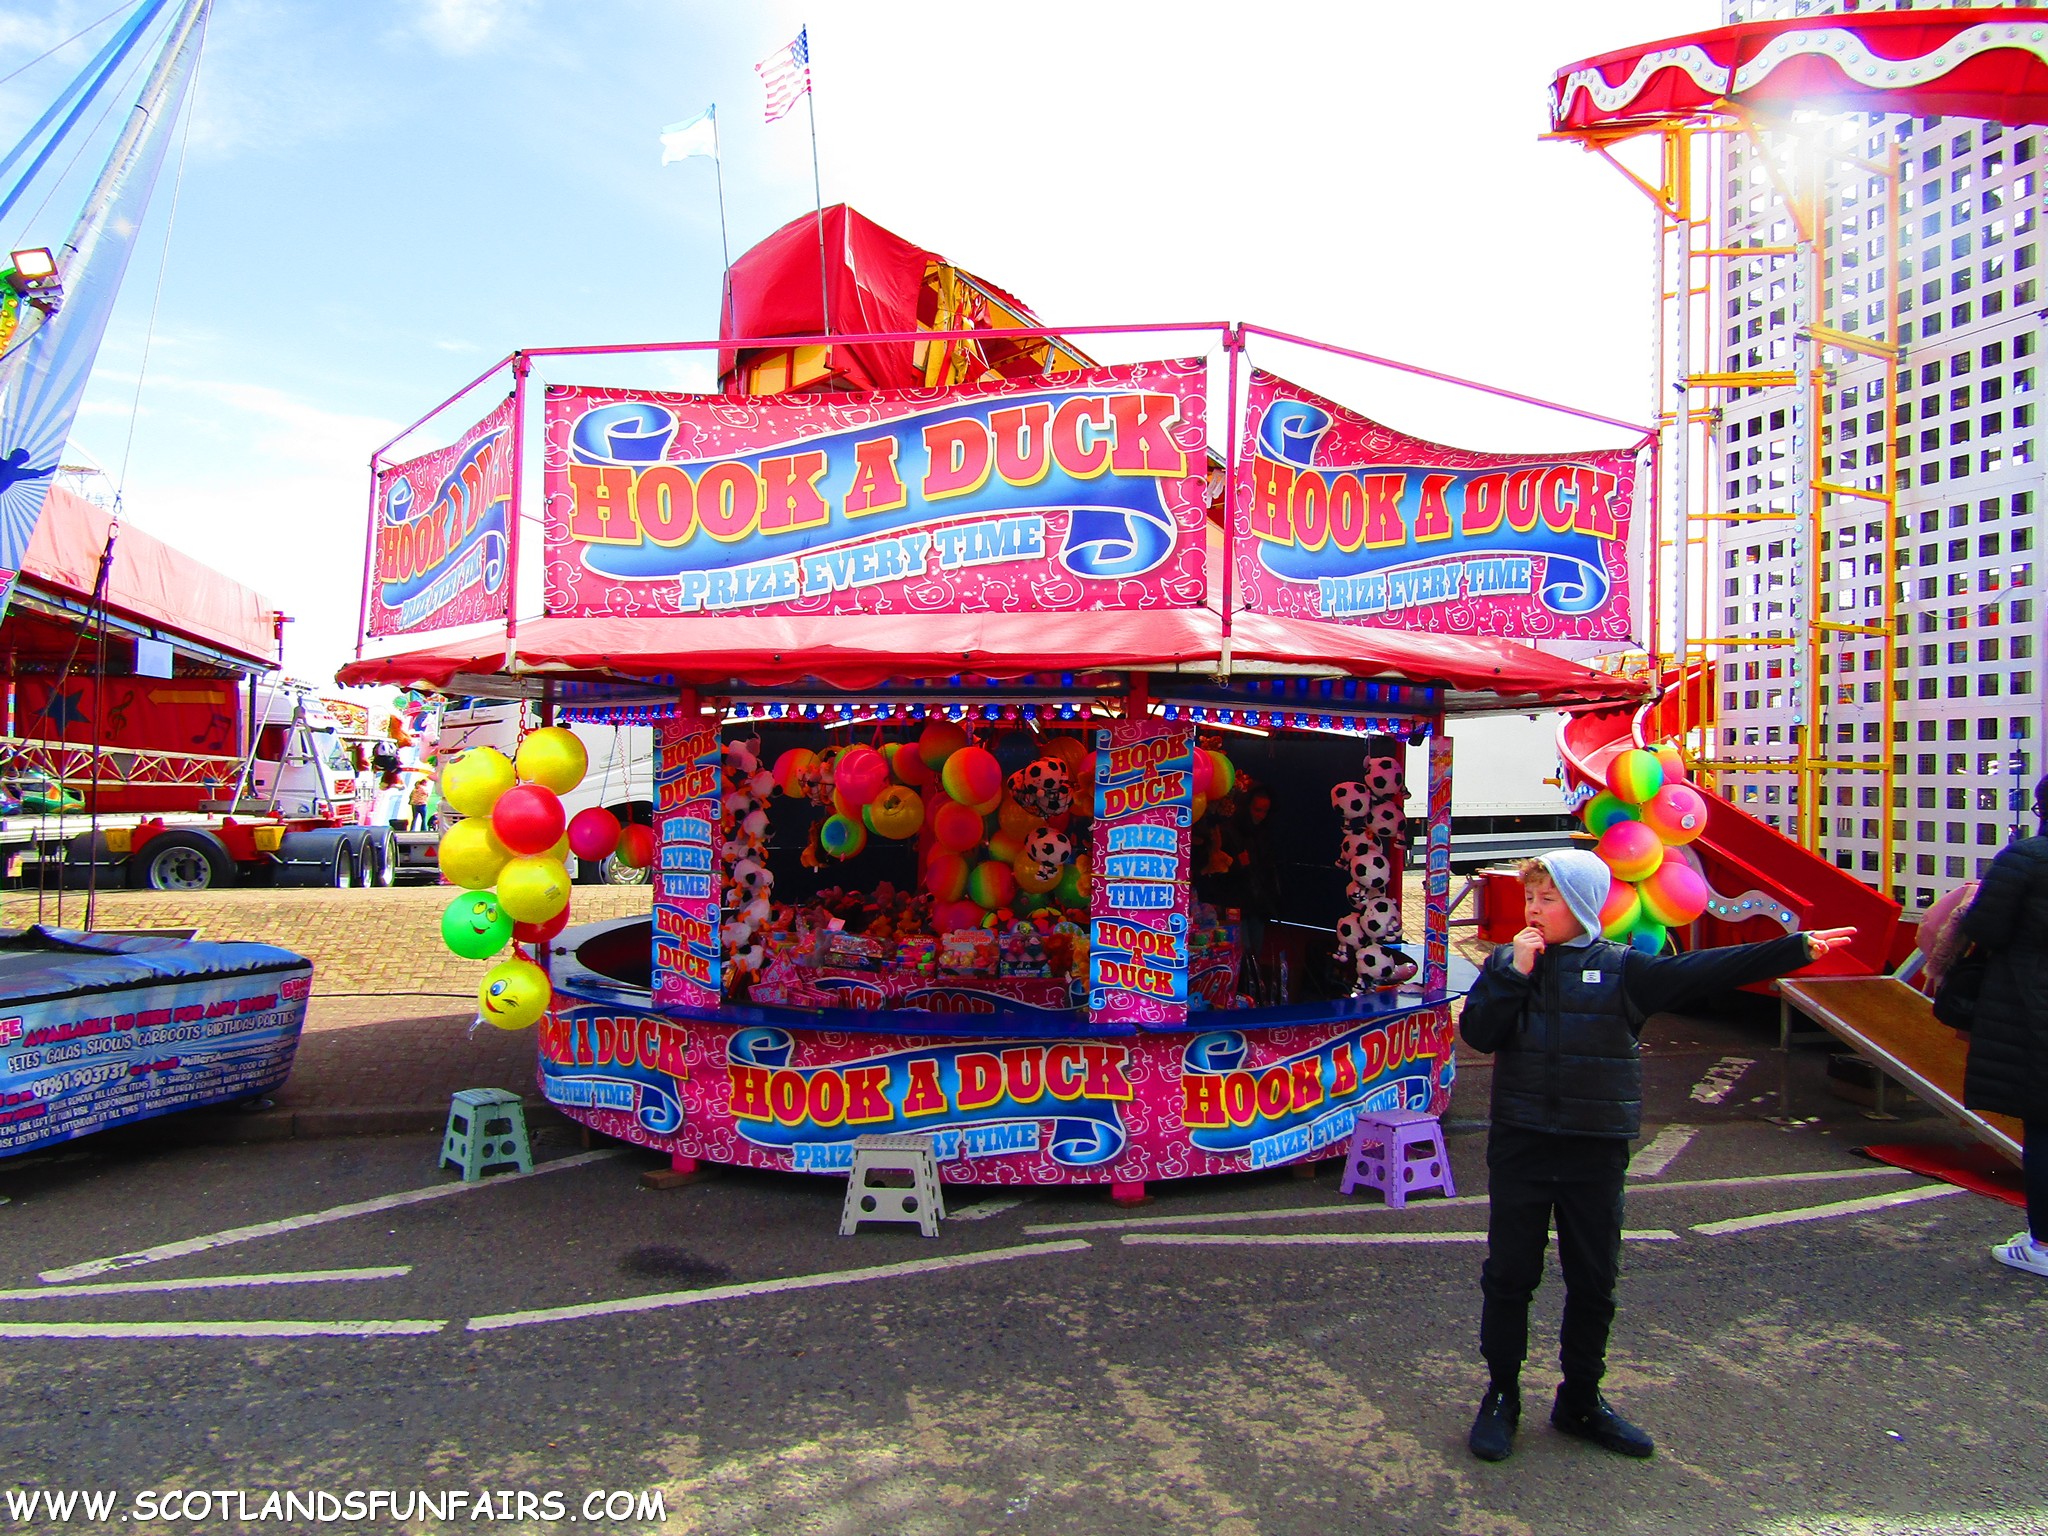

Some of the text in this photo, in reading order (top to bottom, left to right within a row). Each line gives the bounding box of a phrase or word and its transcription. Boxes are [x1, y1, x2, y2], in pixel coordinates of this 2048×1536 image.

[568, 393, 1189, 548] HOOK A DUCK
[380, 432, 512, 584] HOOK A DUCK
[1251, 454, 1618, 553] HOOK A DUCK
[679, 517, 1045, 608] PRIZE EVERY TIME
[1319, 558, 1531, 616] PRIZE EVERY TIME
[662, 729, 717, 771] HOOK
[685, 754, 696, 777] A
[1110, 734, 1189, 776] HOOK
[1143, 759, 1158, 781] A
[659, 766, 716, 810] DUCK
[1104, 772, 1185, 817] DUCK
[663, 818, 710, 842] PRIZE
[1107, 825, 1178, 853] PRIZE
[662, 846, 712, 871] EVERY
[1106, 855, 1178, 880] EVERY
[663, 875, 710, 897] TIME!
[1107, 884, 1174, 909] TIME!
[657, 908, 713, 948] HOOK
[1097, 922, 1176, 959] HOOK
[1428, 908, 1447, 933] HOOK
[658, 943, 711, 983] DUCK
[680, 934, 690, 952] A
[1131, 947, 1146, 968] A
[1428, 942, 1446, 966] DUCK
[1099, 960, 1174, 997] DUCK
[7, 1009, 295, 1073] FETES GALAS SHOWS CARBOOTS BIRTHDAY PARTIES
[23, 1016, 112, 1047] AVAILABLE
[114, 1013, 135, 1031] TO
[136, 1008, 172, 1028] HIRE
[174, 1004, 204, 1022] FOR
[204, 1001, 237, 1018] ANY
[239, 994, 278, 1014] EVENT
[576, 1018, 594, 1065] A
[594, 1017, 689, 1080] DUCK
[728, 1044, 1134, 1127] HOOK A DUCK
[1182, 1055, 1323, 1128] HOOK
[1330, 1042, 1358, 1098] A
[1361, 1011, 1438, 1083] DUCK
[0, 1126, 17, 1138] TEMS
[32, 1116, 48, 1127] LEFT
[73, 1105, 90, 1117] RISK
[93, 1091, 145, 1112] RESPONSIBILITY
[146, 1088, 161, 1099] FOR
[162, 1081, 195, 1096] CHILDREN
[68, 1092, 94, 1105] REMOVE
[95, 1089, 106, 1099] ALL
[107, 1084, 129, 1096] LOOSE
[129, 1080, 150, 1091] ITEMS
[594, 1081, 633, 1111] TIME
[15, 1130, 39, 1145] LISTEN
[40, 1127, 51, 1138] TO
[62, 1114, 98, 1130] ATTENDANT
[122, 1103, 139, 1116] TIMES
[1251, 1084, 1400, 1168] PRIZE EVERY TIME
[794, 1142, 853, 1172] PRIZ
[963, 1122, 1040, 1156] TIME
